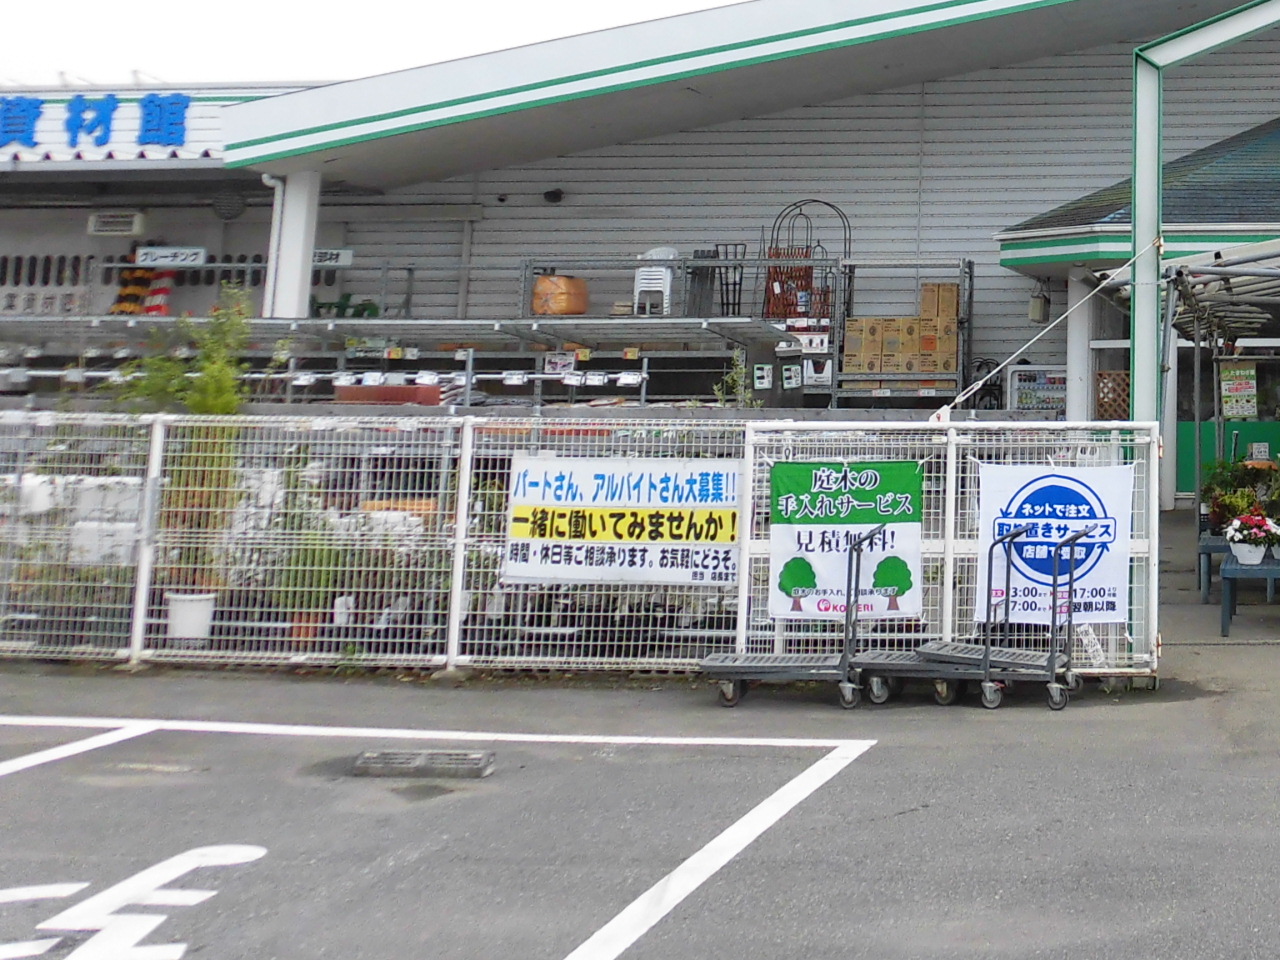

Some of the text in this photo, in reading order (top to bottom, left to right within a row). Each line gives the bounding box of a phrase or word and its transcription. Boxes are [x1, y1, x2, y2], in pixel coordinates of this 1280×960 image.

[140, 250, 200, 263] グレーチング
[811, 468, 880, 492] 庭木の
[778, 493, 913, 518] 手入れサービス
[1022, 503, 1090, 517] ネットで注文
[832, 604, 873, 613] KOERI
